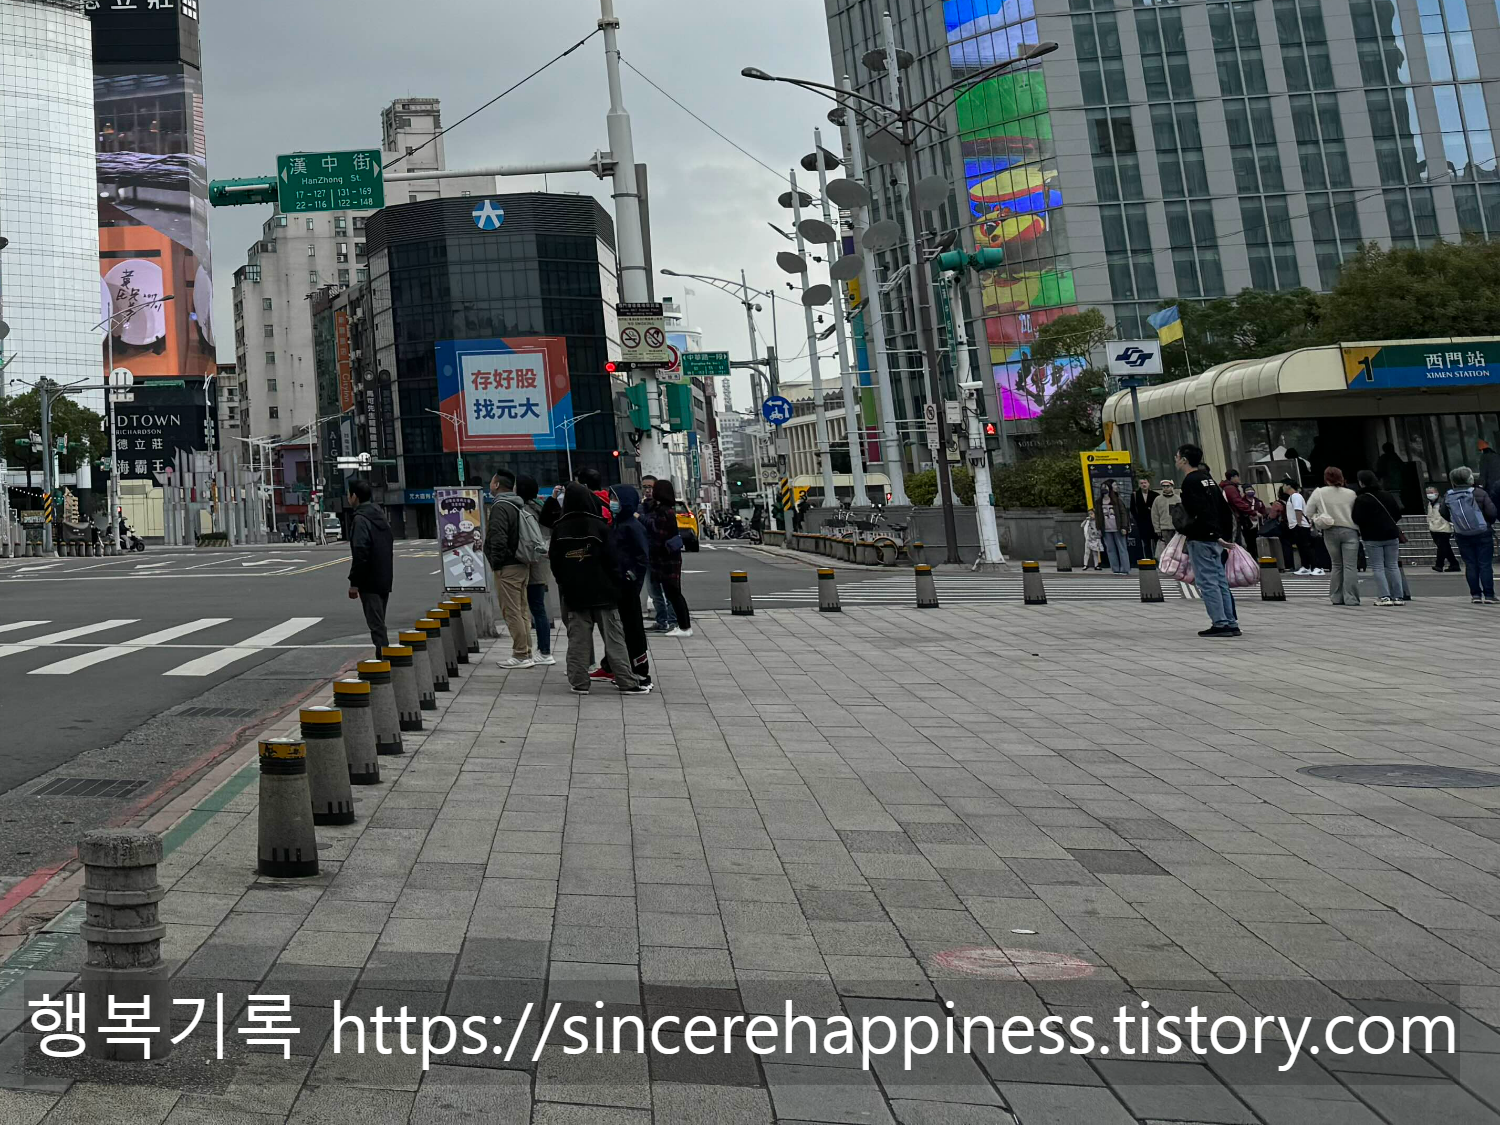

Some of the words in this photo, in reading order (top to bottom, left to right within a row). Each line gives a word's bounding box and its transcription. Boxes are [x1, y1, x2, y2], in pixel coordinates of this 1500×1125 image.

[289, 153, 371, 175] 漢中街
[301, 176, 343, 185] HanZhong
[350, 174, 361, 182] St.
[1358, 356, 1375, 382] 1
[1424, 350, 1486, 370] 西門站
[470, 368, 538, 391] 存好股
[1426, 371, 1453, 379] XIMEN
[1454, 370, 1490, 378] STATION
[473, 397, 541, 421] 找元大
[117, 438, 163, 450] 德立莊
[117, 459, 164, 475] 海霸王
